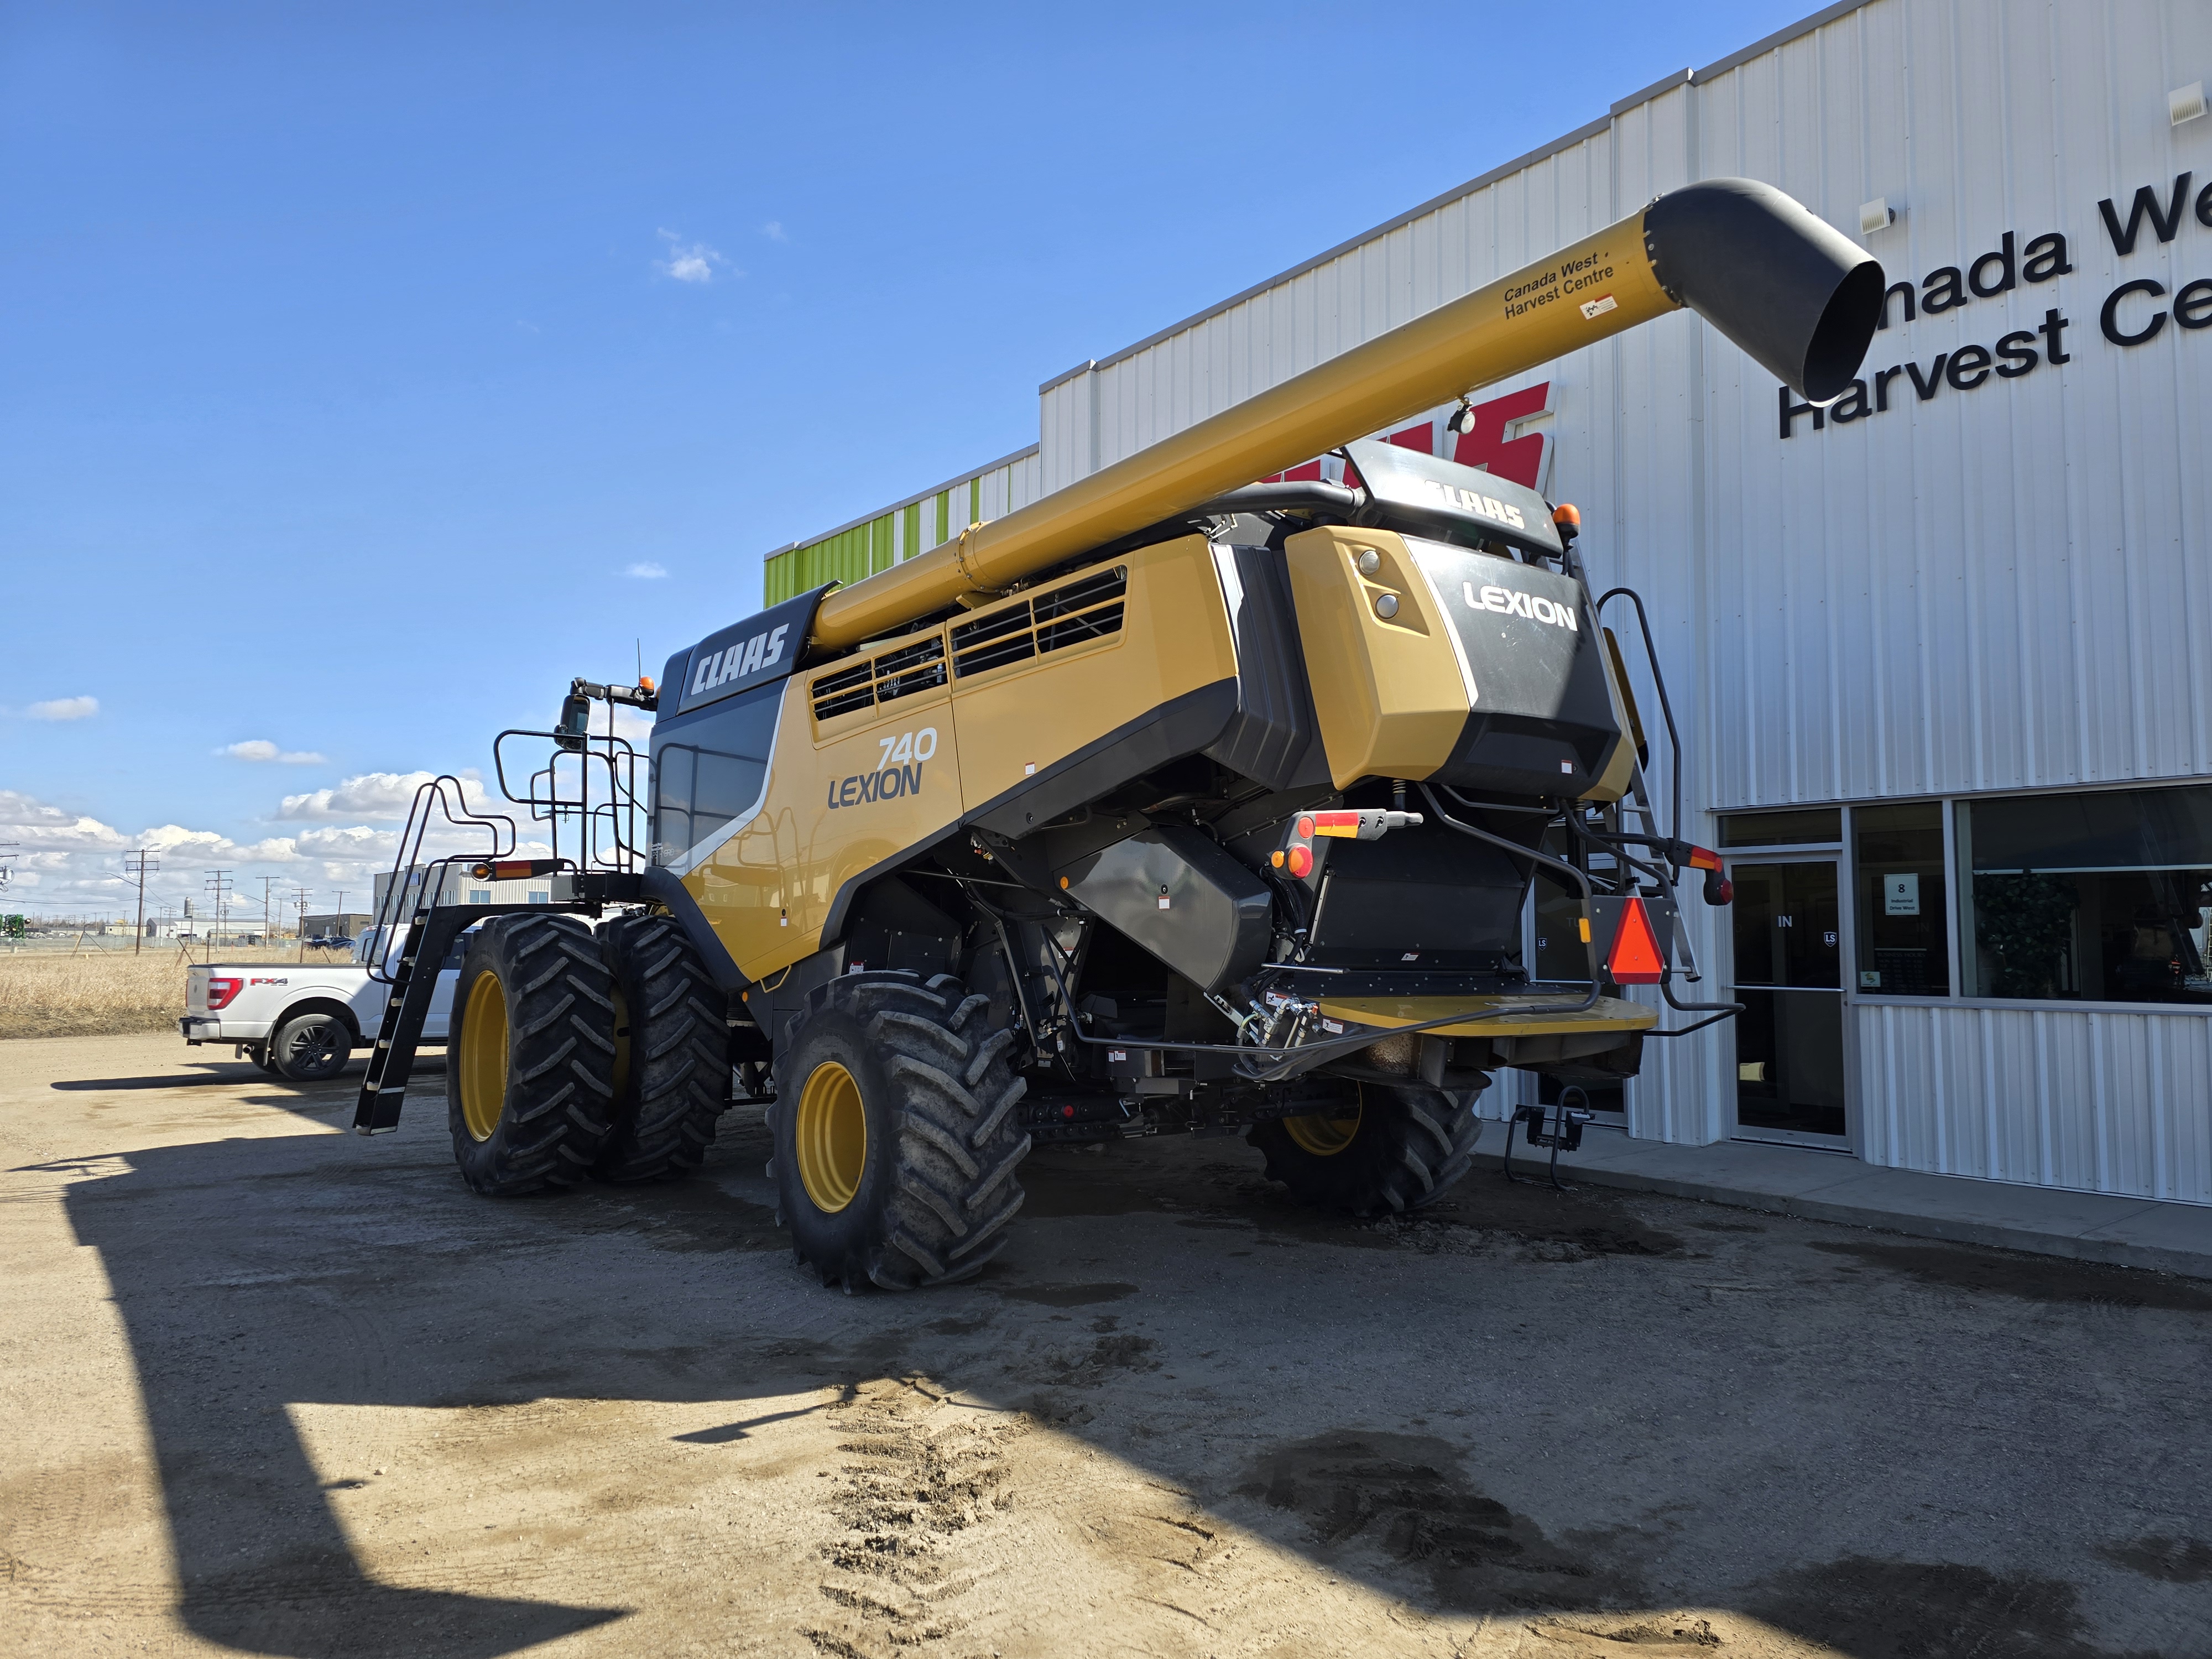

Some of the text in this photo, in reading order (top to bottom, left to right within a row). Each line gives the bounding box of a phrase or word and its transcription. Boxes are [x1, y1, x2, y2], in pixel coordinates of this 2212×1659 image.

[1504, 252, 1598, 302] Canada West
[1505, 288, 1560, 320] Harvest
[1563, 267, 1614, 294] Centre
[1877, 231, 2072, 331] nada
[1779, 308, 2070, 439] Harvest
[1463, 581, 1578, 631] LEXION
[691, 623, 790, 695] CLAAS
[877, 727, 937, 770] 740
[828, 762, 922, 810] LEXION
[1898, 884, 1905, 893] 8
[1778, 916, 1792, 927] IN
[250, 978, 288, 986] FX4
